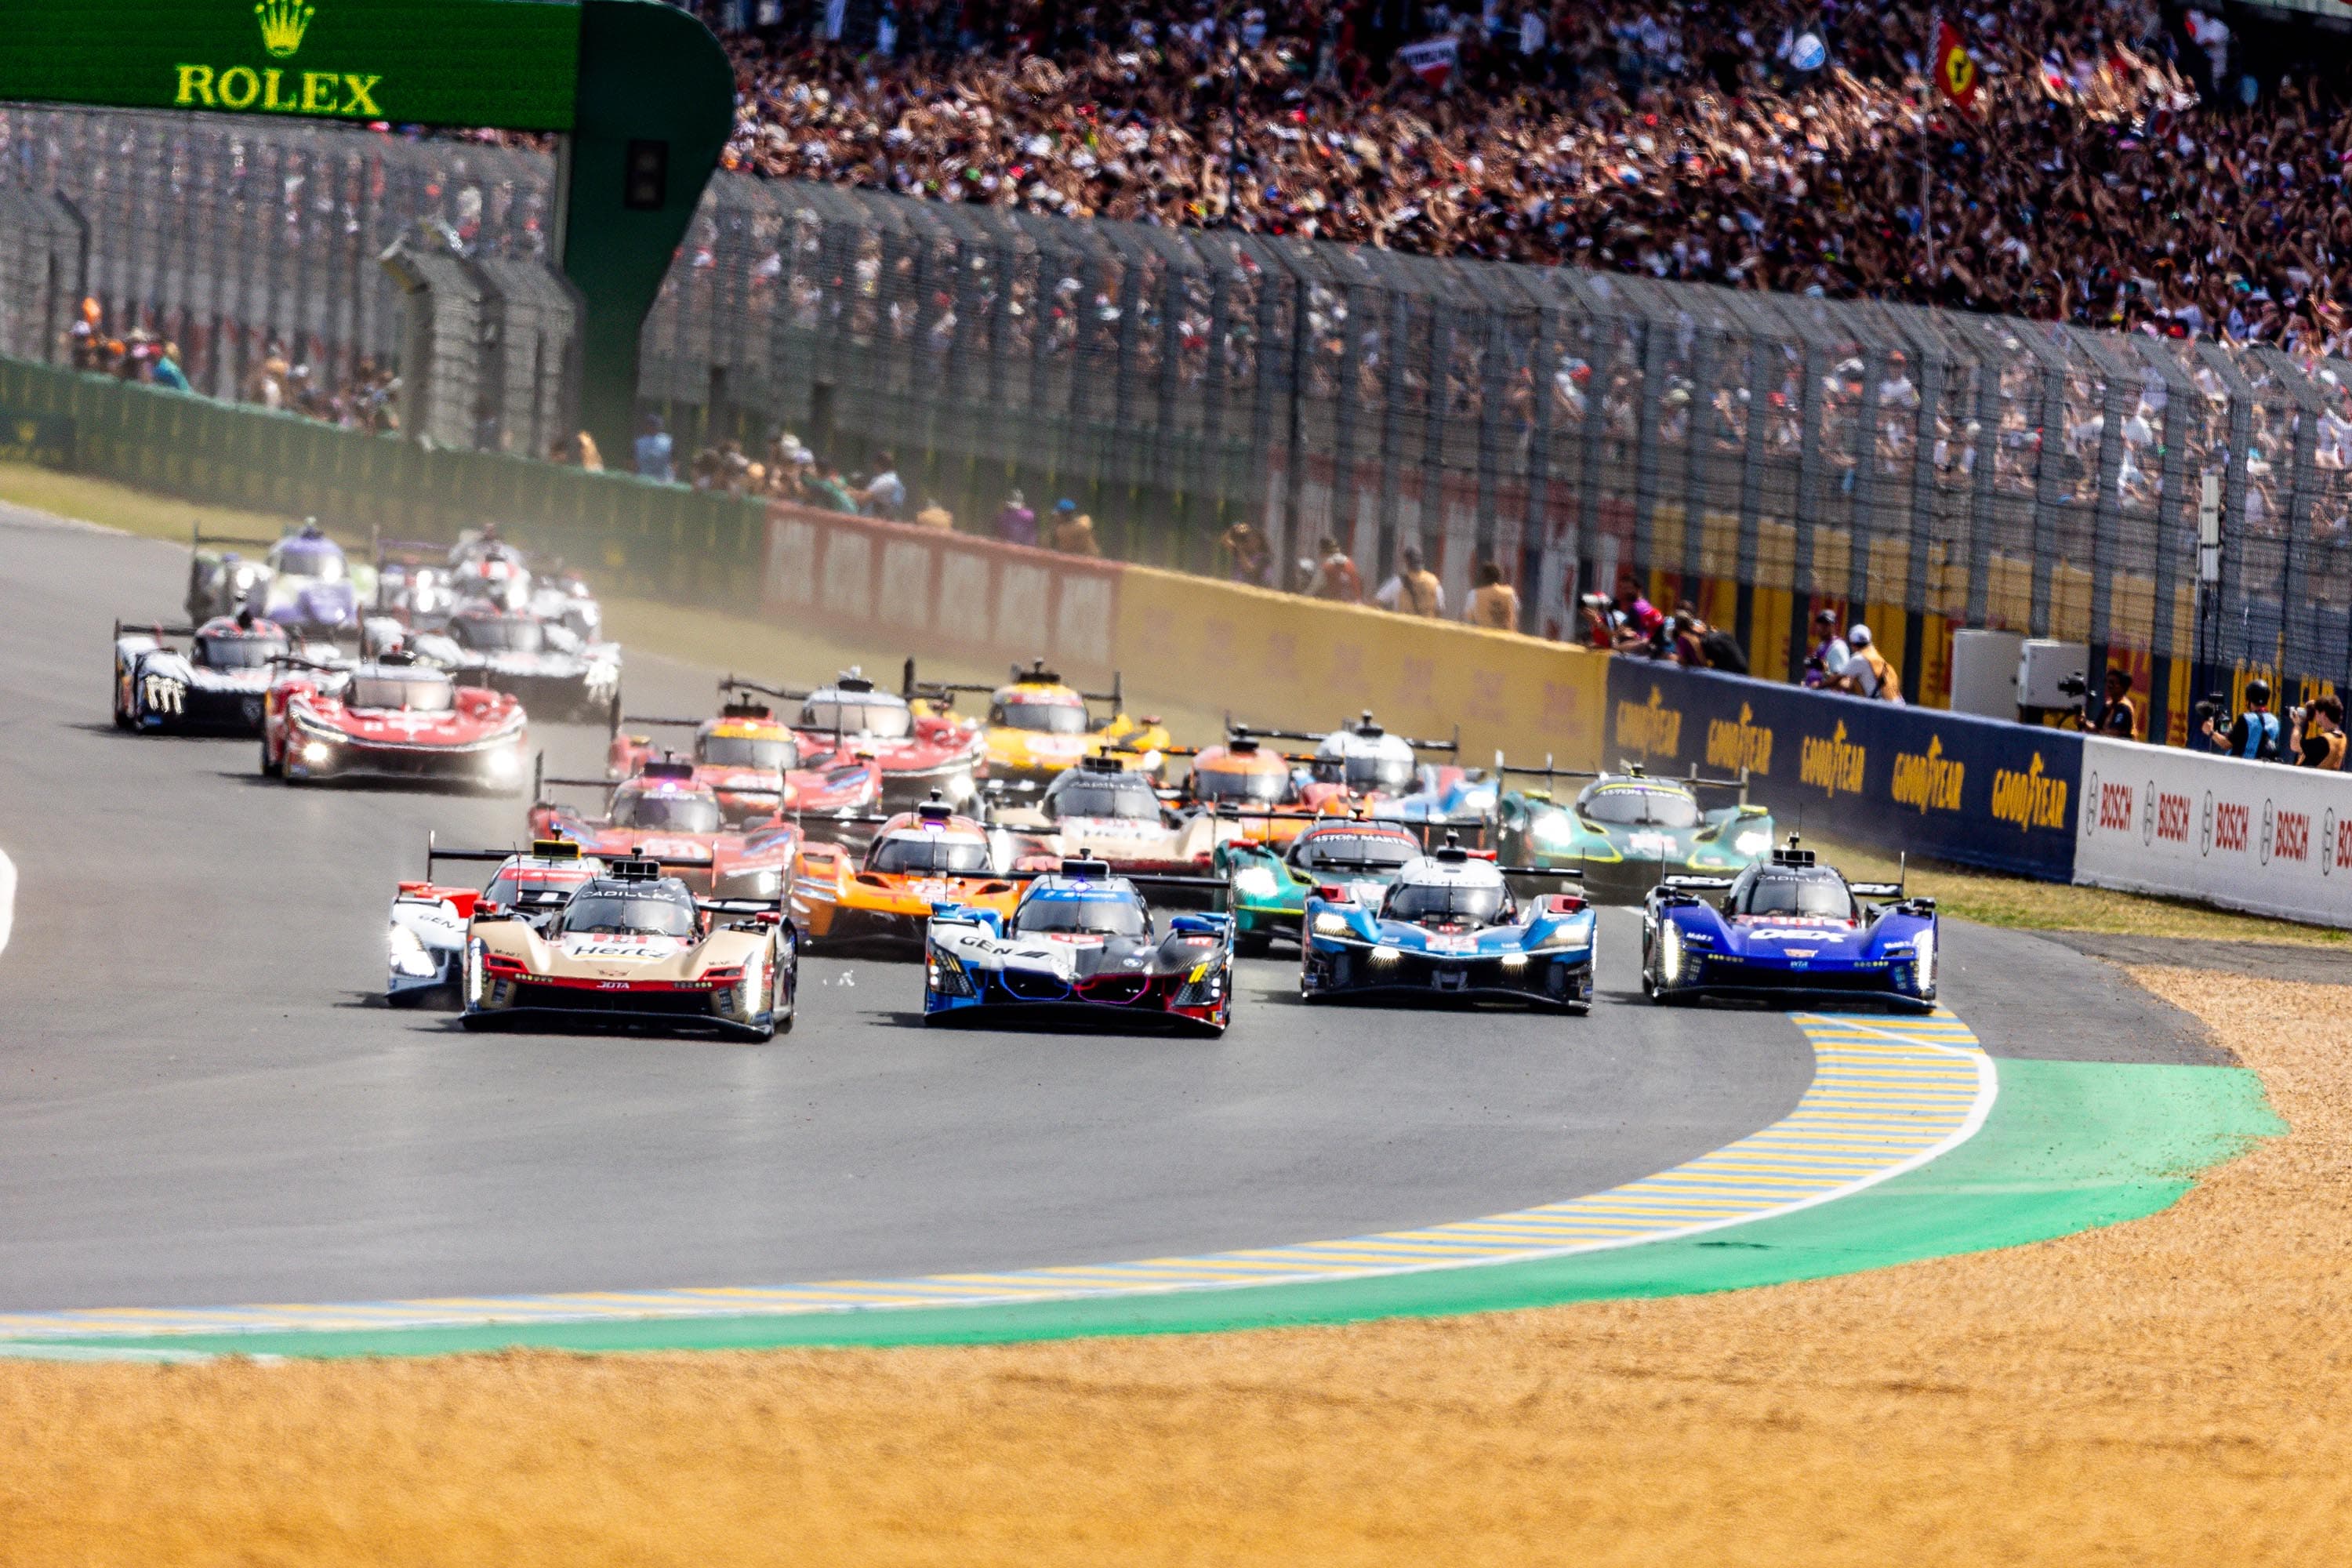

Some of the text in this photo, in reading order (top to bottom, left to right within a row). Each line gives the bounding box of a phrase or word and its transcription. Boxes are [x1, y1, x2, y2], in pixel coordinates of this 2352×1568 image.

[176, 63, 383, 116] ROLEX
[1706, 717, 1773, 776] GOODYEAR
[1800, 735, 1865, 795] GOODYEAR
[1892, 752, 1965, 811] GOODYEAR
[1992, 768, 2067, 829] GOODYEAR
[2100, 782, 2132, 831] BOSCH
[2158, 792, 2190, 843] BOSCH
[2216, 802, 2249, 852] BOSCH
[1312, 834, 1358, 843] ASTON
[2275, 810, 2310, 862] BOSCH
[2337, 820, 2352, 869] BO
[583, 890, 676, 901] CADILLAC
[1756, 874, 1836, 885] CADILLAC
[419, 913, 455, 929] GEN
[960, 935, 1012, 955] GEN
[1748, 928, 1849, 943] DEX
[574, 945, 669, 959] Hertz
